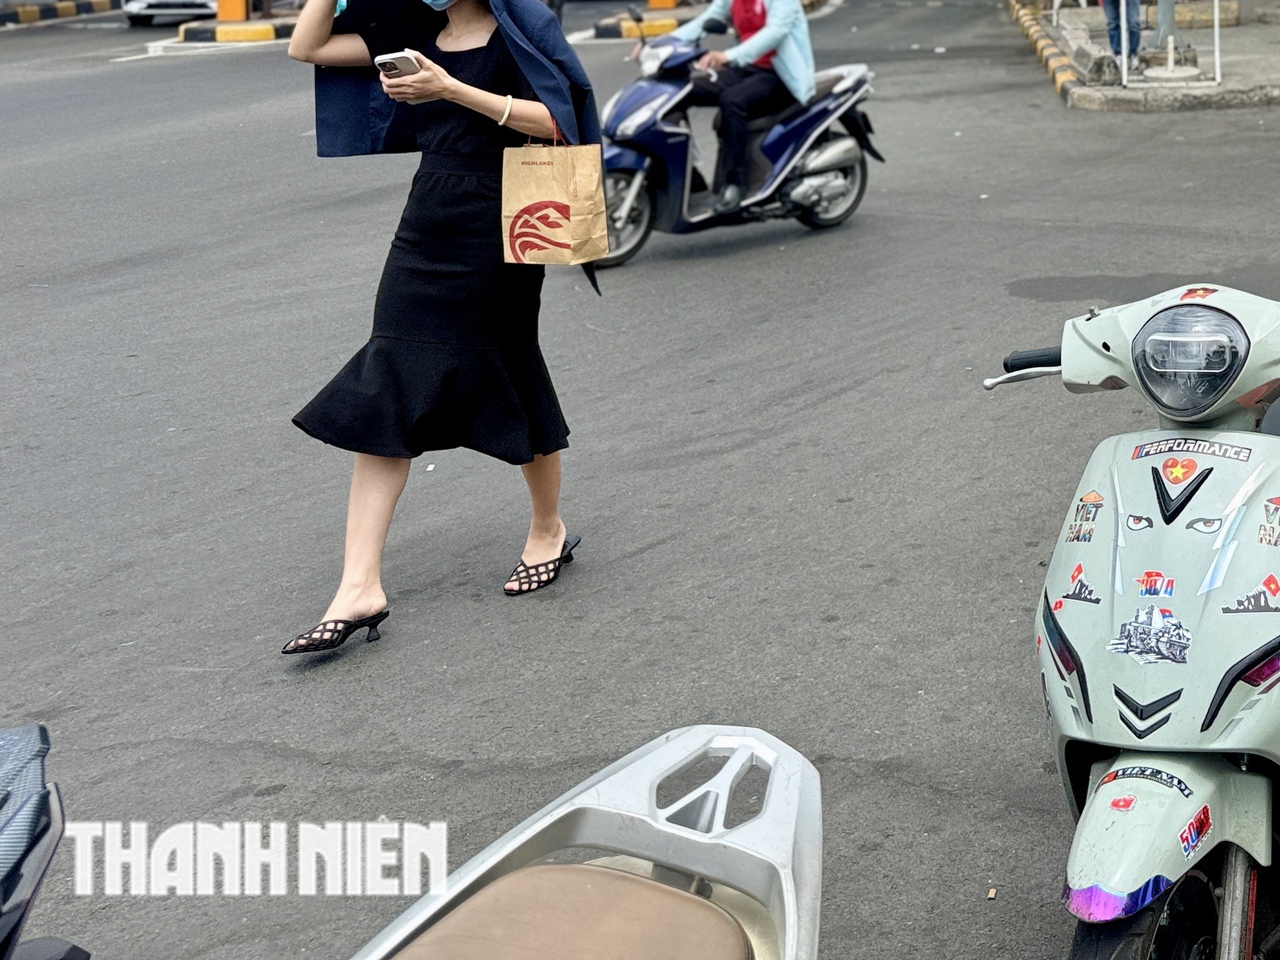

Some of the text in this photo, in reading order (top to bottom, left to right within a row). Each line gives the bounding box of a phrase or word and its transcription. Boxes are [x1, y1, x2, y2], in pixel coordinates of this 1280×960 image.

[1141, 439, 1251, 461] PERFORMANCE
[1074, 503, 1104, 522] VIET
[1065, 523, 1096, 543] NAM
